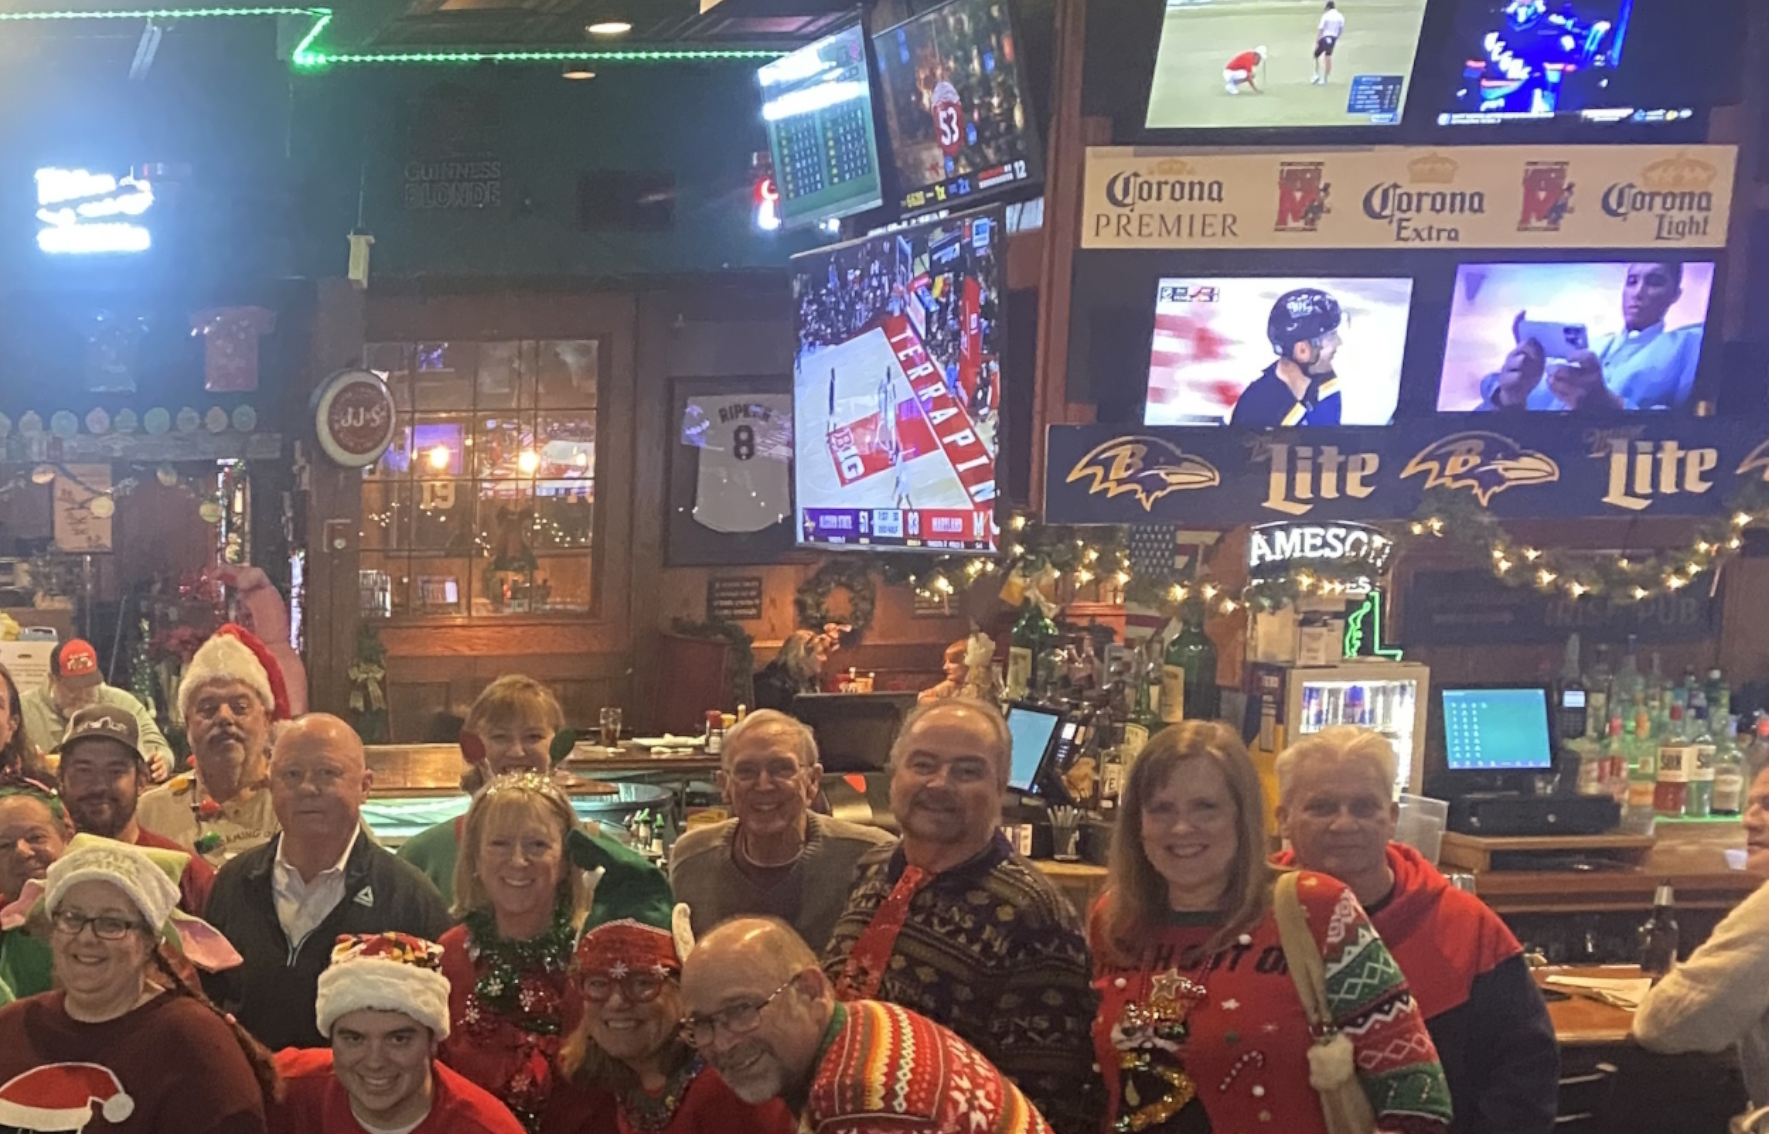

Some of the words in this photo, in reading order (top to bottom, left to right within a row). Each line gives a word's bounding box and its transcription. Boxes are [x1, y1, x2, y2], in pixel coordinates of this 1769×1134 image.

[938, 107, 960, 146] 53
[1013, 160, 1027, 180] 12
[1106, 170, 1224, 212] Corona
[1362, 181, 1486, 225] Corona
[1601, 182, 1713, 222] Corona
[1094, 213, 1240, 239] PREMIER
[1395, 217, 1460, 244] Extra
[1655, 213, 1709, 241] Light
[733, 424, 755, 461] 8
[1261, 441, 1379, 515] Lite
[1602, 440, 1718, 510] Lite
